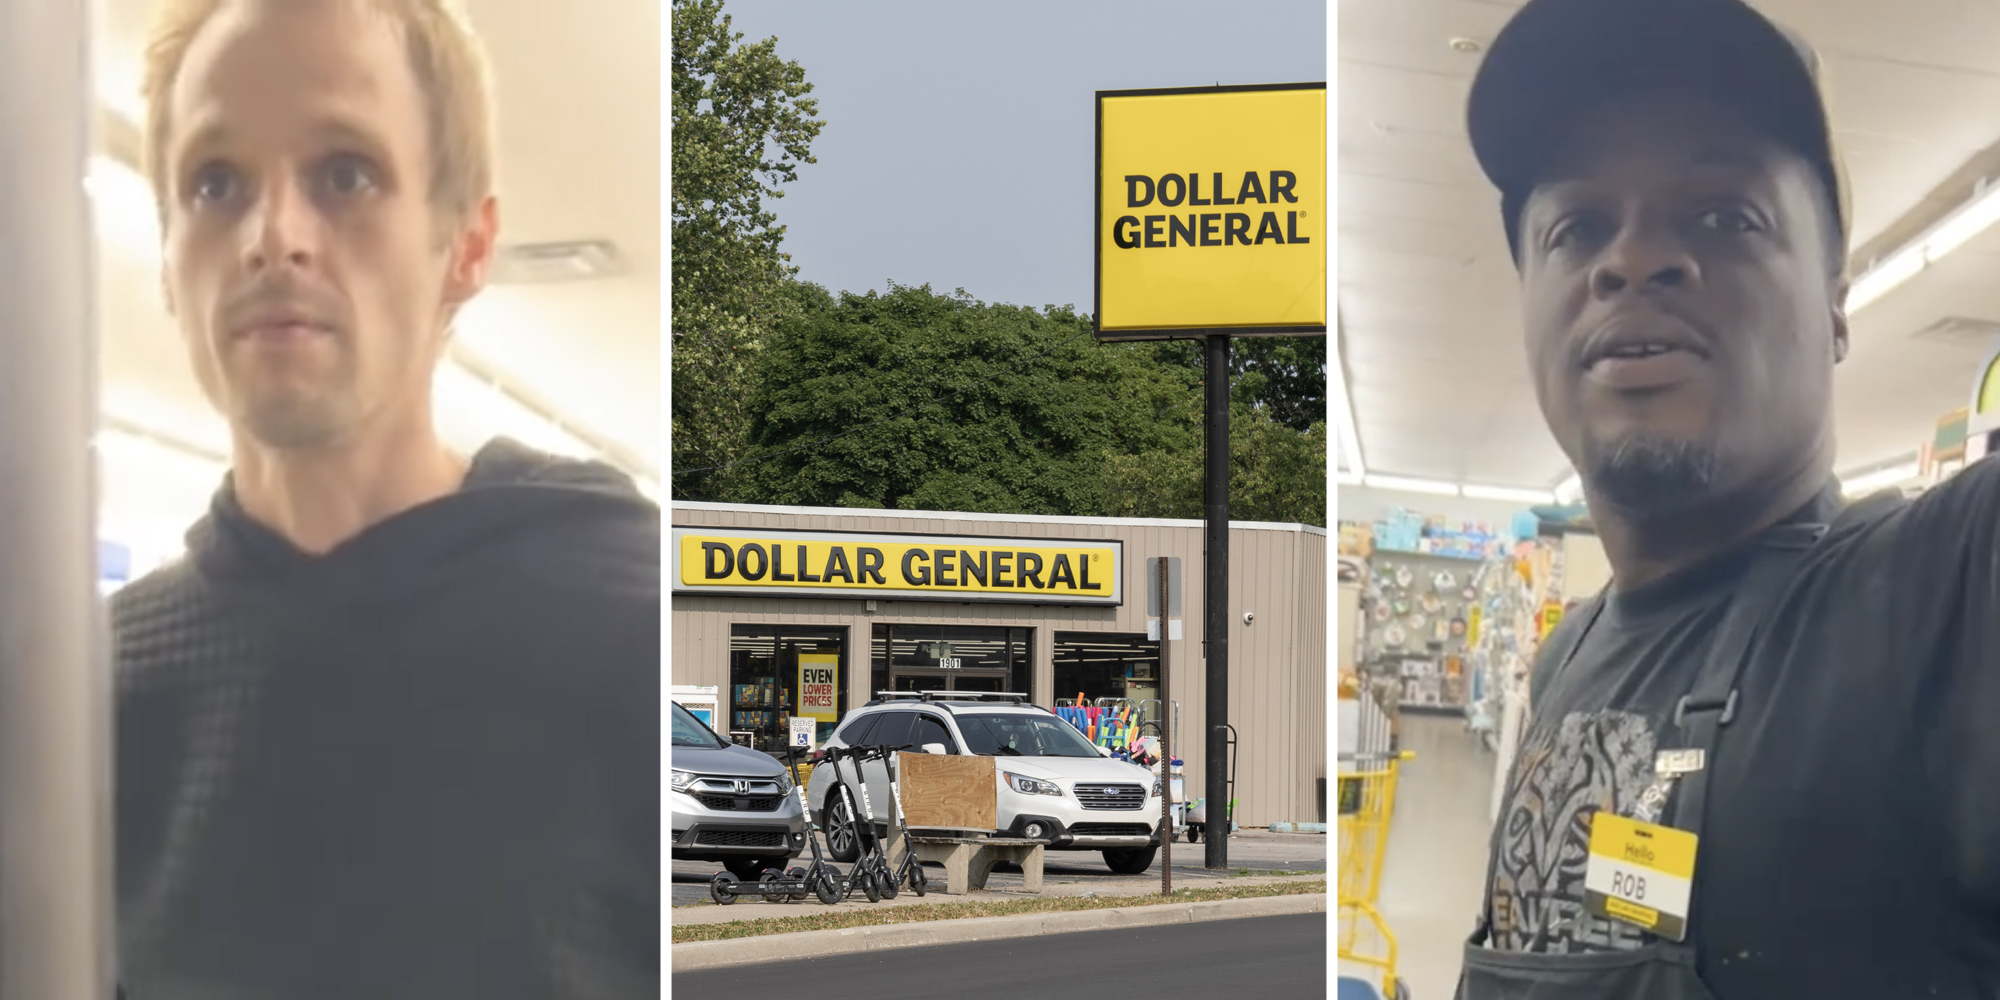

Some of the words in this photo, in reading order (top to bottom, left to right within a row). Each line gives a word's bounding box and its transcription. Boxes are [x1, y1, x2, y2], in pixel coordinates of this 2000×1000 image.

[1124, 170, 1299, 208] DOLLAR
[1113, 211, 1310, 249] GENERAL
[701, 541, 887, 584] DOLLAR
[901, 548, 1101, 590] GENERAL
[941, 658, 960, 668] 1901
[803, 668, 833, 684] EVEN
[803, 684, 832, 695] LOWER
[803, 695, 832, 707] PRICES
[792, 719, 814, 727] RESERVED
[793, 726, 812, 734] PARKING
[799, 792, 810, 815] BIRD
[1625, 841, 1656, 862] Hello
[1611, 870, 1647, 900] ROB
